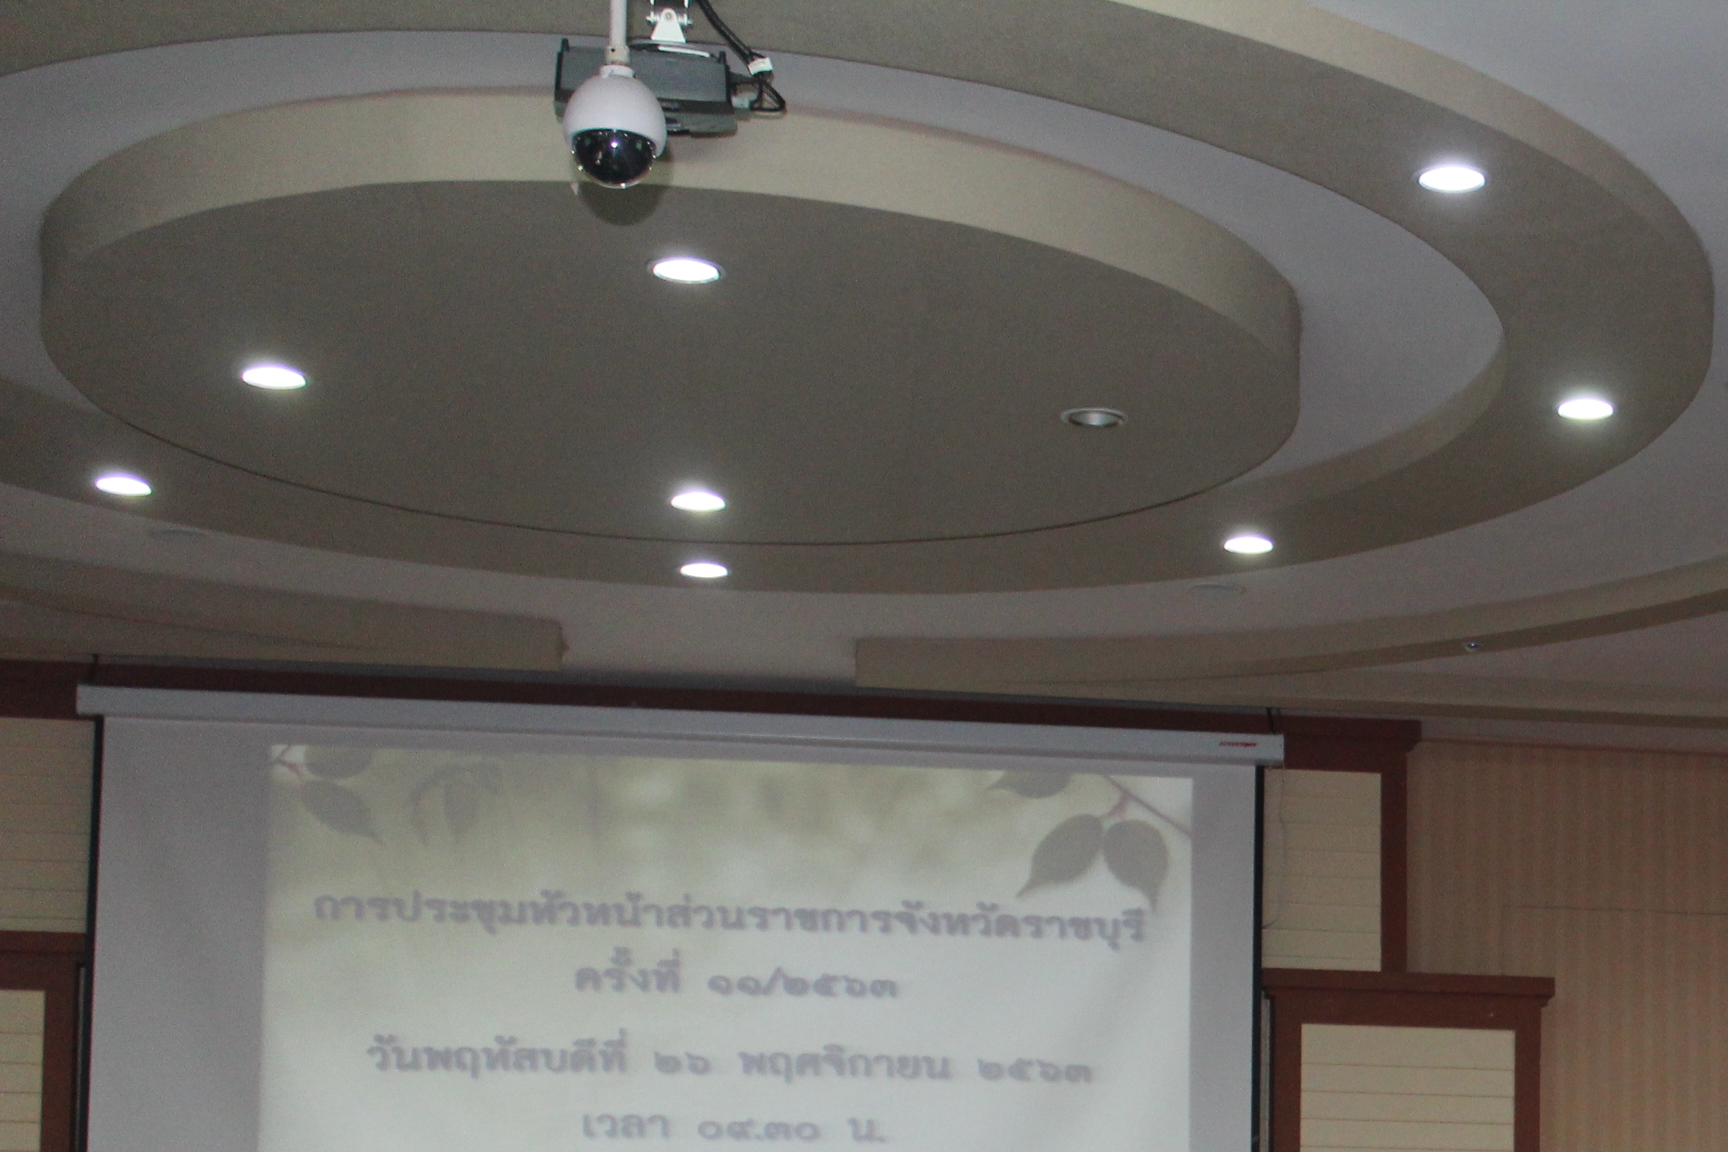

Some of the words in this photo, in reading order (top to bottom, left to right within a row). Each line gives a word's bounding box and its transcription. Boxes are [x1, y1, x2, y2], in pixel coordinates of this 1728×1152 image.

[314, 889, 1147, 951] การประชุมหัวหน้าส่วนราชการจังหวัดราชบุรี
[574, 946, 681, 993] ครั้งที่
[706, 966, 899, 998] ๑๑/๒๕๖๓
[367, 1028, 629, 1079] วันพฤหัสบดีที่
[653, 1051, 713, 1075] ๒๖
[738, 1043, 952, 1085] พฤศจิกายน
[976, 1056, 1094, 1084] ๒๕๖๓
[582, 1113, 671, 1139] เวลา
[847, 1117, 888, 1143] น.
